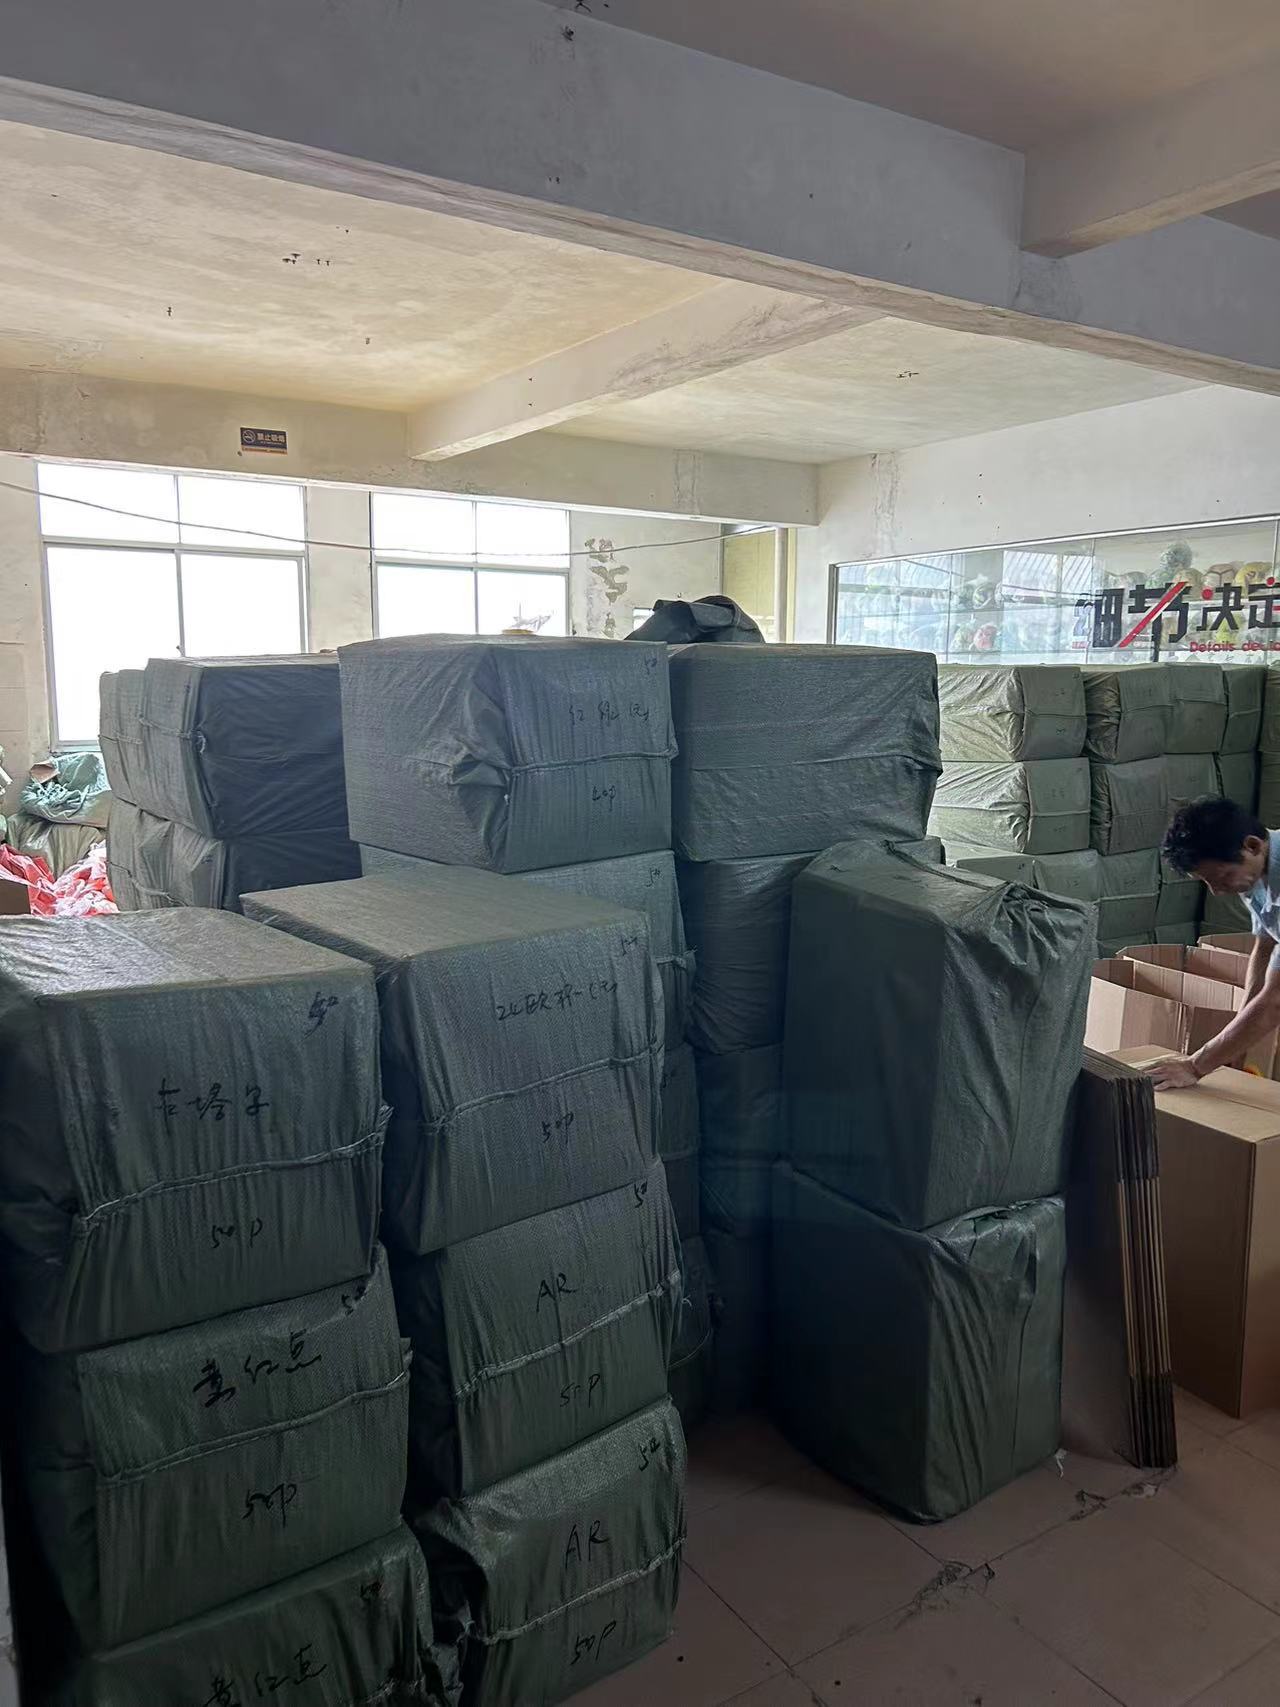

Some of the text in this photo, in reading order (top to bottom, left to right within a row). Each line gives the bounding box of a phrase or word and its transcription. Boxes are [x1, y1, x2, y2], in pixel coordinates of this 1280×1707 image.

[1189, 640, 1236, 653] Details
[536, 1272, 579, 1312] AR
[565, 1520, 610, 1572] AR
